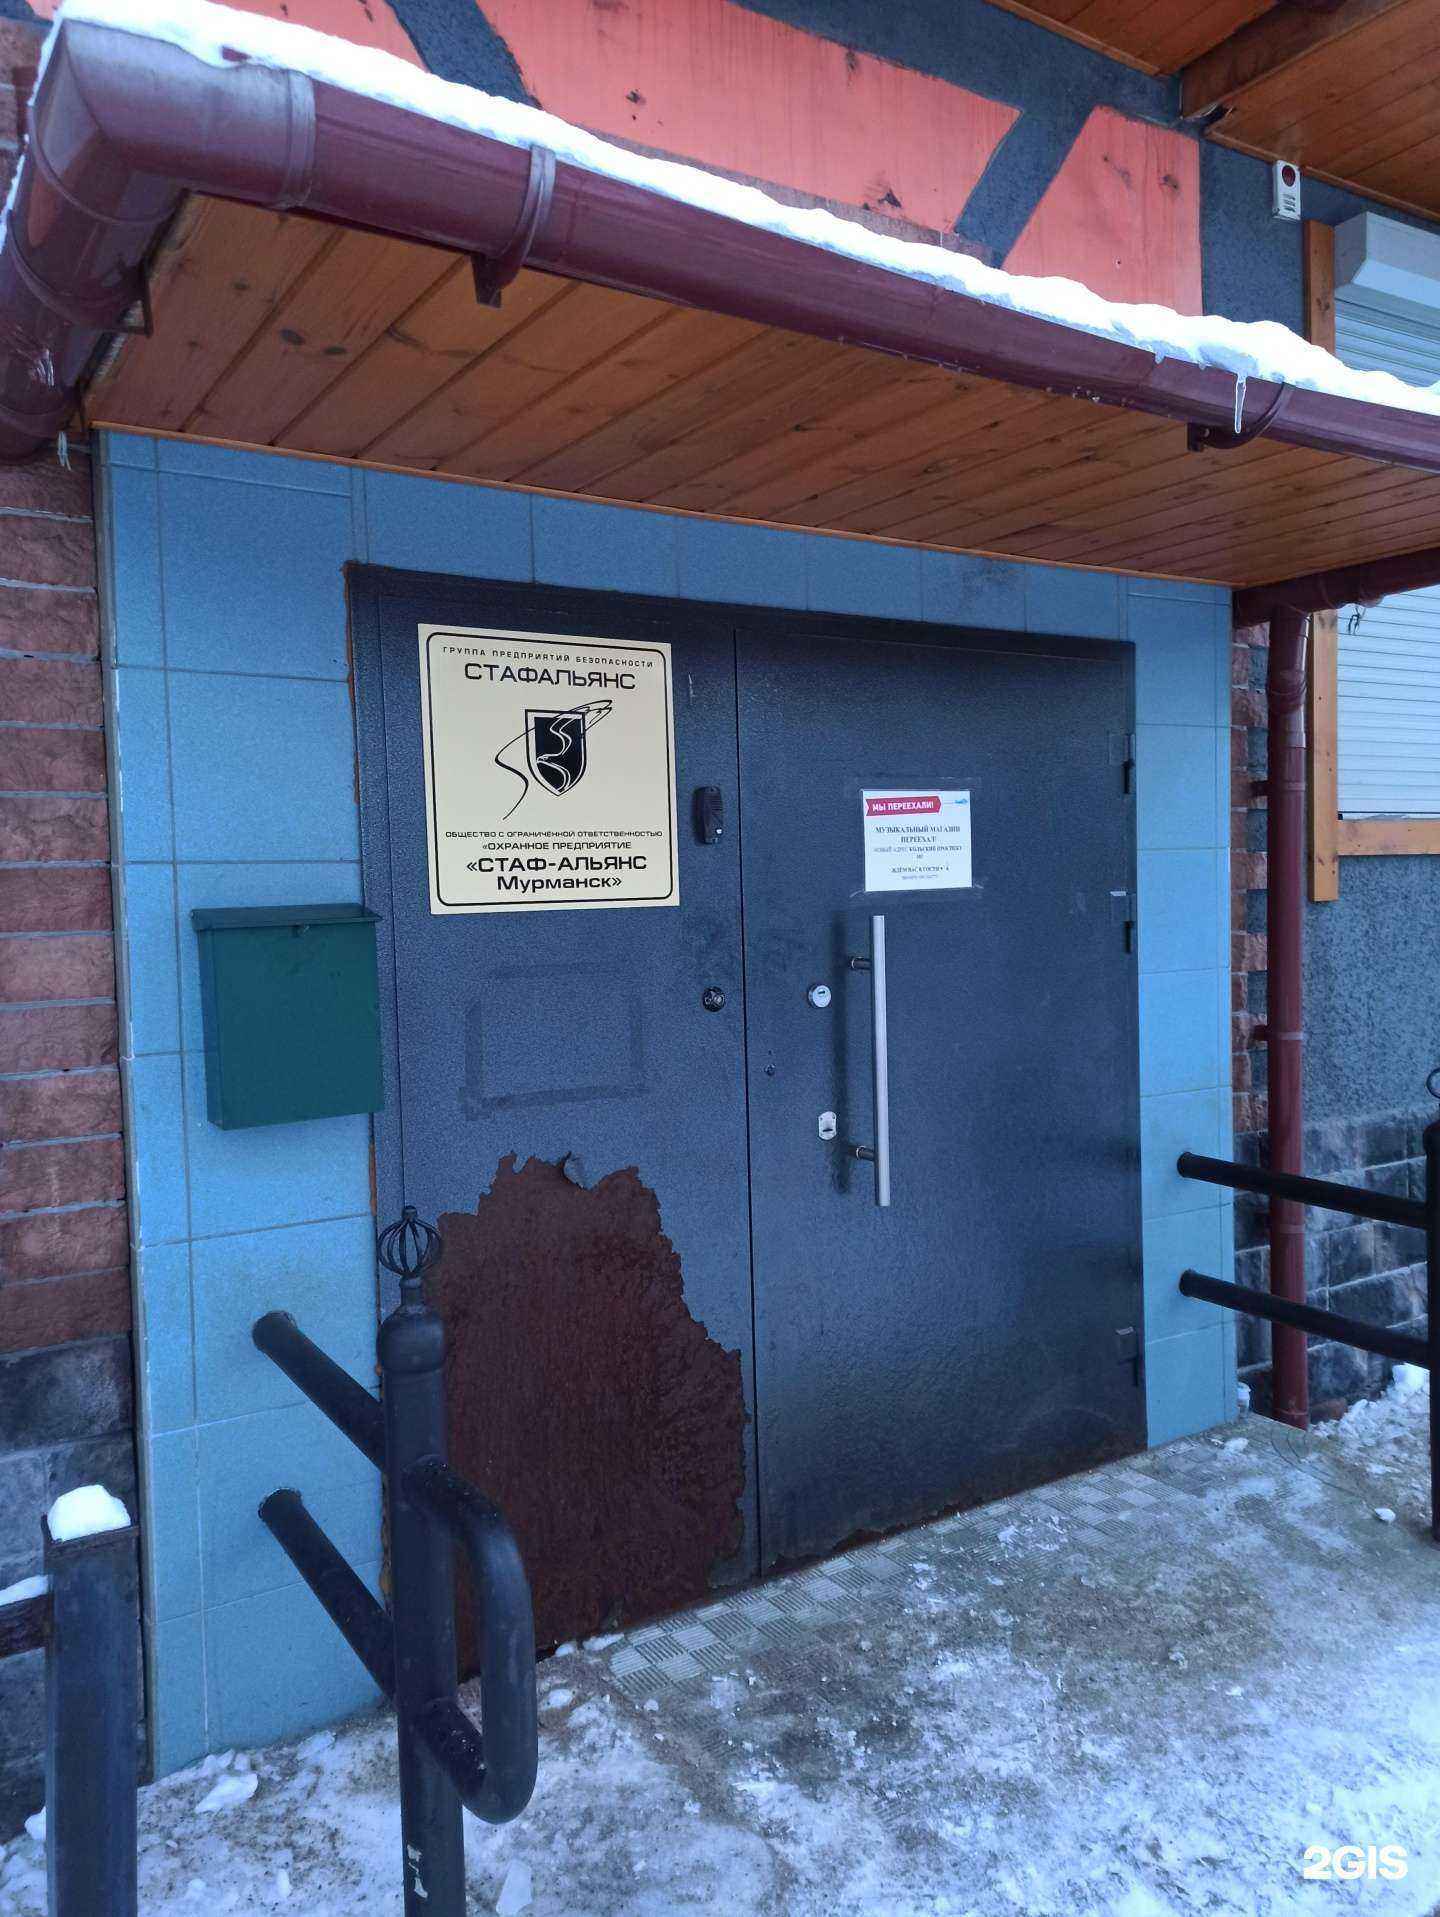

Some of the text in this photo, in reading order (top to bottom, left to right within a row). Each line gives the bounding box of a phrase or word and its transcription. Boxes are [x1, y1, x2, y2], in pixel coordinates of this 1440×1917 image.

[442, 646, 654, 668] ГРУППА ПРЕДПРИЯТИЙ БЕЗОПАСНОСТИ
[464, 662, 636, 690] СТАФАЛЬЯНС
[872, 801, 934, 812] МЫ ПЕРЕЕХАЛИ!
[445, 830, 497, 838] ОБЩЕСТВО
[506, 830, 576, 838] ОГРАНИЧЕННОЙ
[482, 841, 632, 851] «ОХРАННОЕ ПРЕДПРИЯТИЕ
[466, 855, 648, 873] «СТАФ-АЛЬЯНС
[496, 875, 622, 893] Мурманск»
